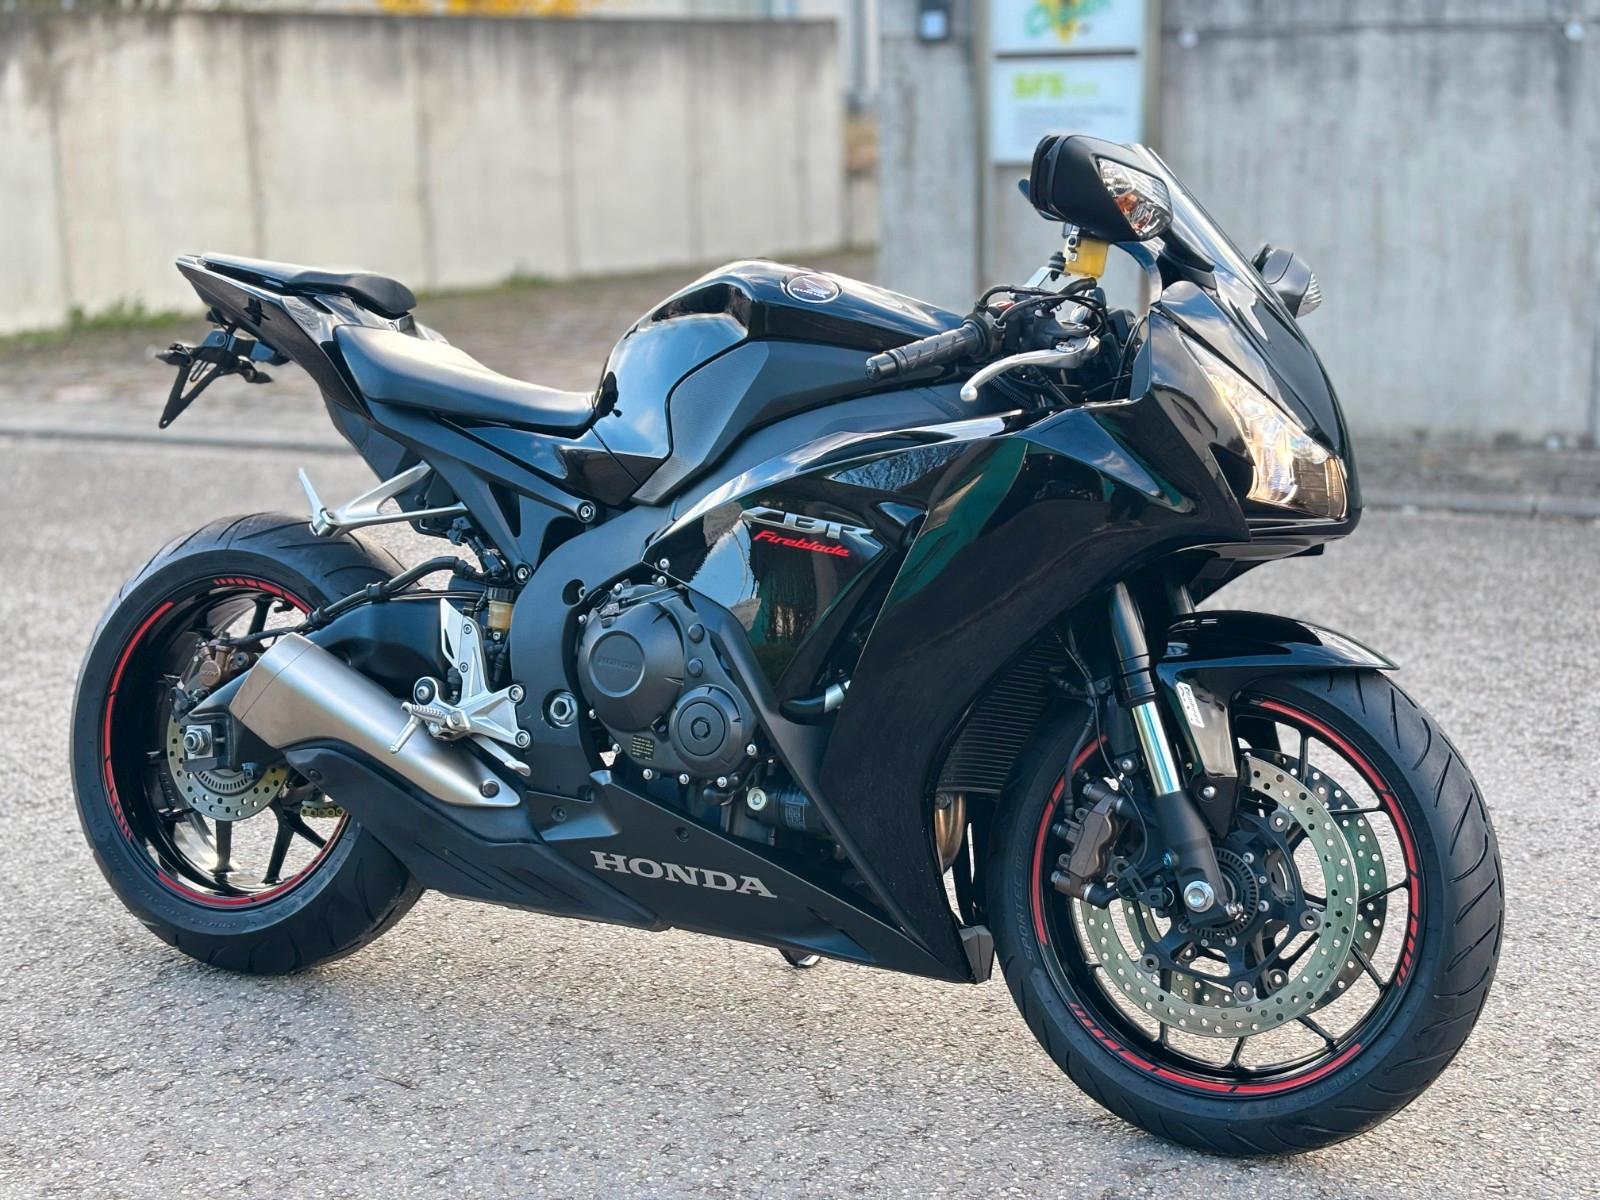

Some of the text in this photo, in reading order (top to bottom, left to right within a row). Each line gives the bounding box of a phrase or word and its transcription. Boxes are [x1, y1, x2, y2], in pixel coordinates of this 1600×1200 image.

[739, 506, 884, 550] CBR
[752, 530, 849, 557] Fireblade
[590, 850, 778, 899] HONDA
